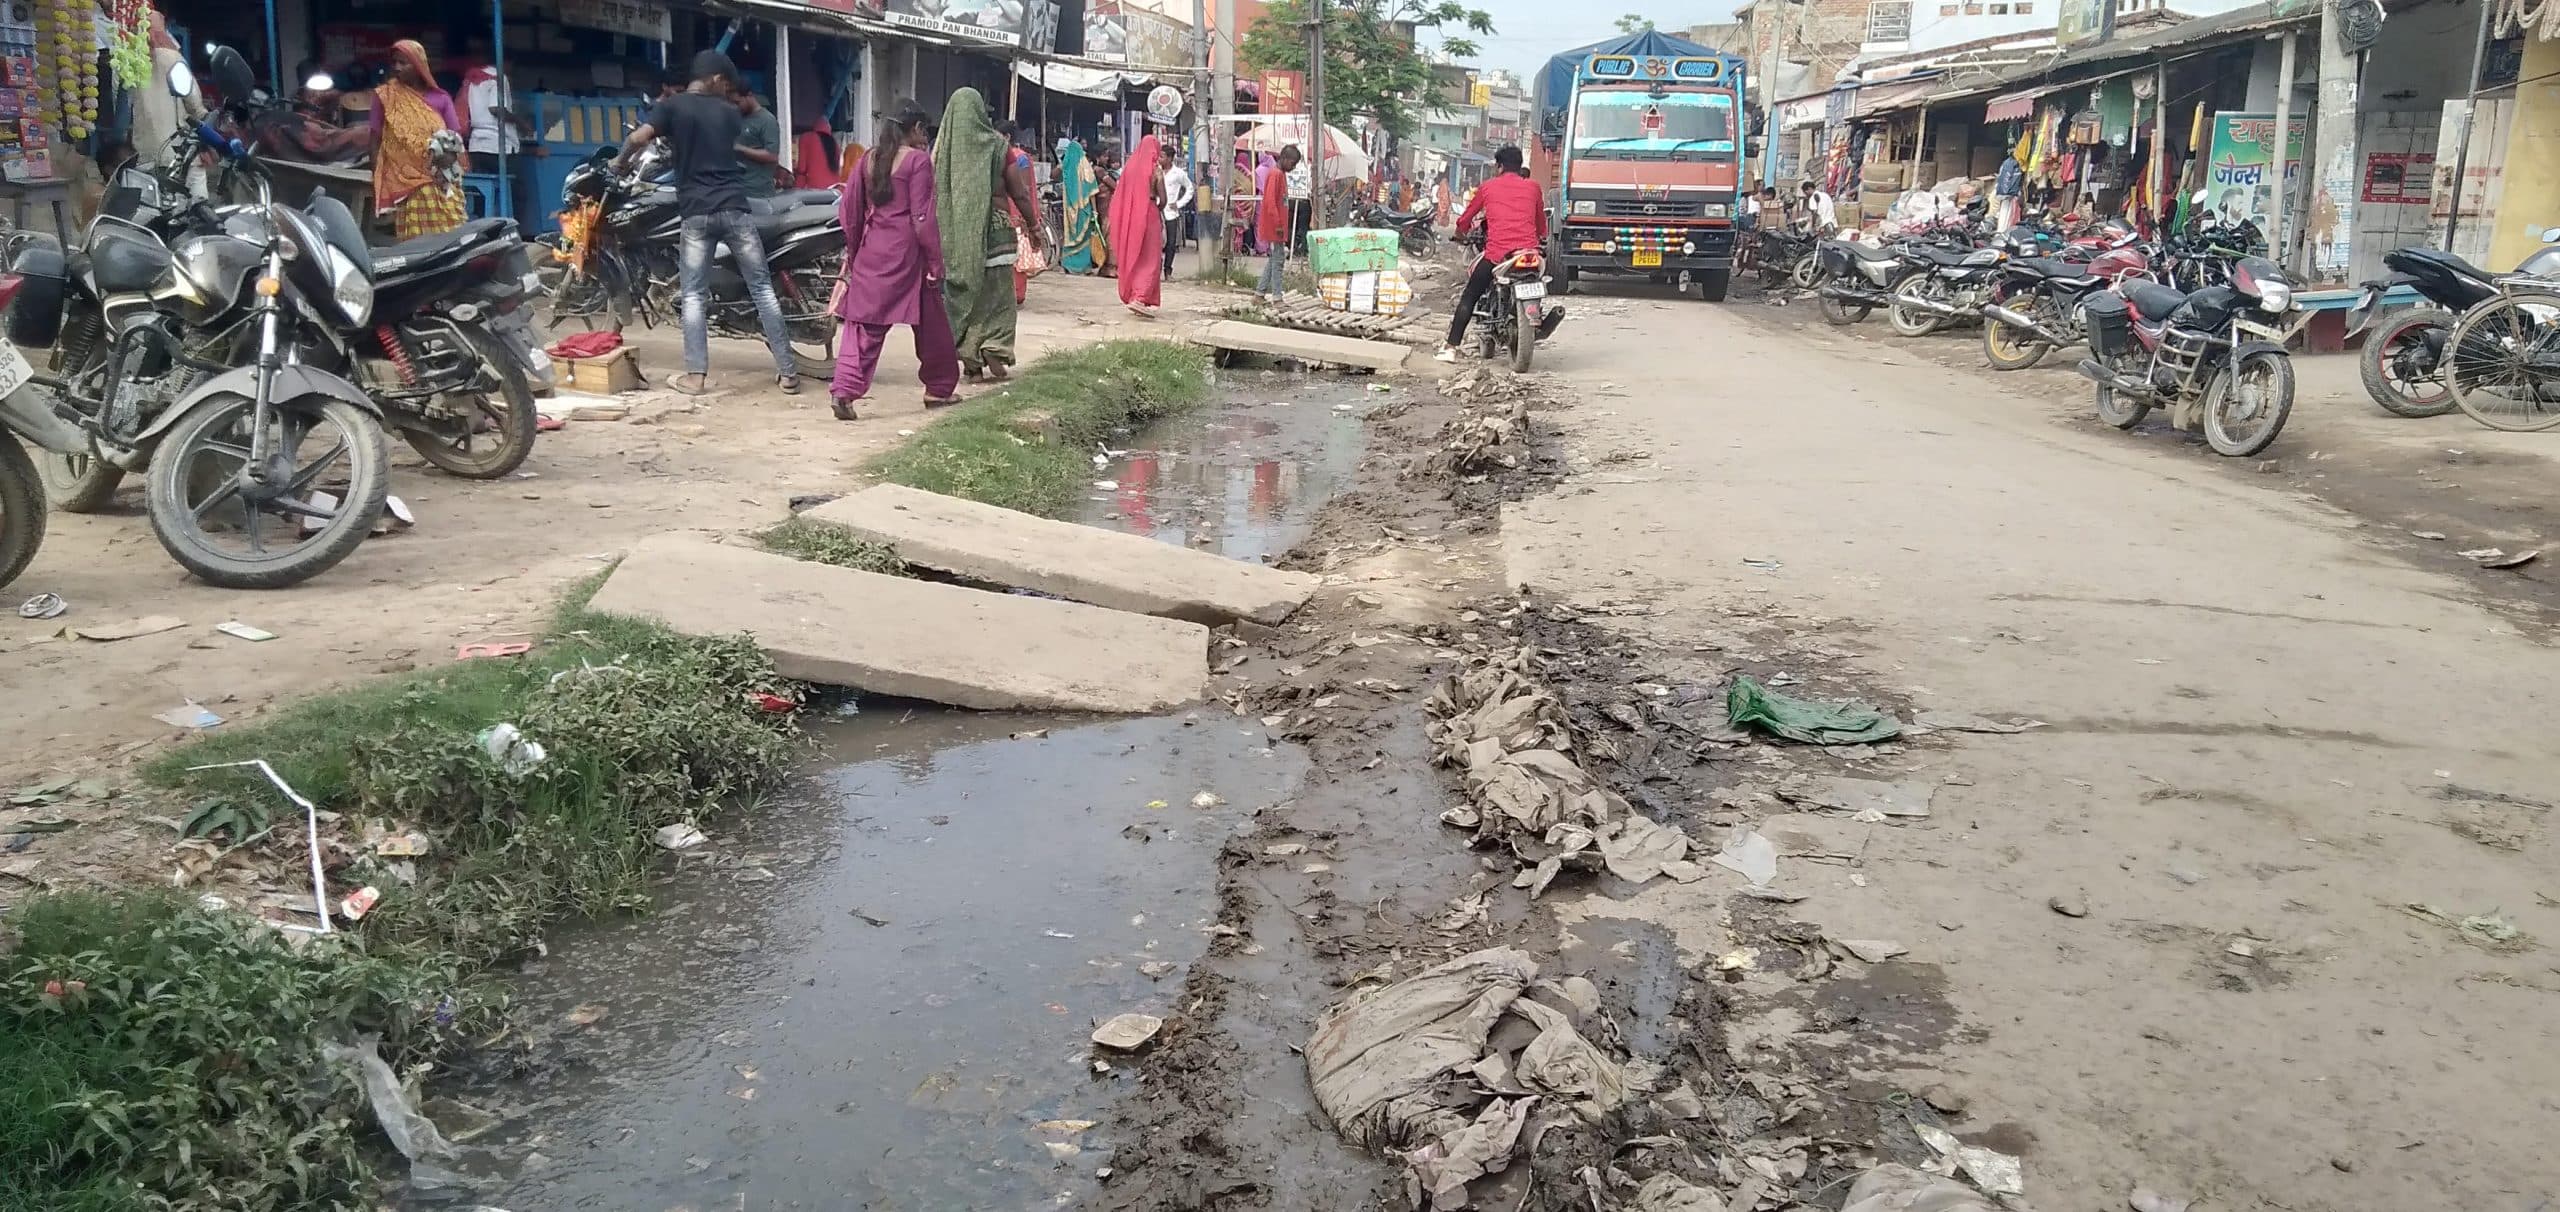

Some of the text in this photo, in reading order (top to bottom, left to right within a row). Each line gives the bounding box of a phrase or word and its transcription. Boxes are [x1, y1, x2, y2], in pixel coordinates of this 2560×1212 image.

[898, 14, 1009, 42] PRAMOD PAN BHANDAR
[1596, 59, 1630, 75] PUBLIC
[1678, 62, 1714, 76] CARRIER
[2213, 153, 2264, 186] जेन्स
